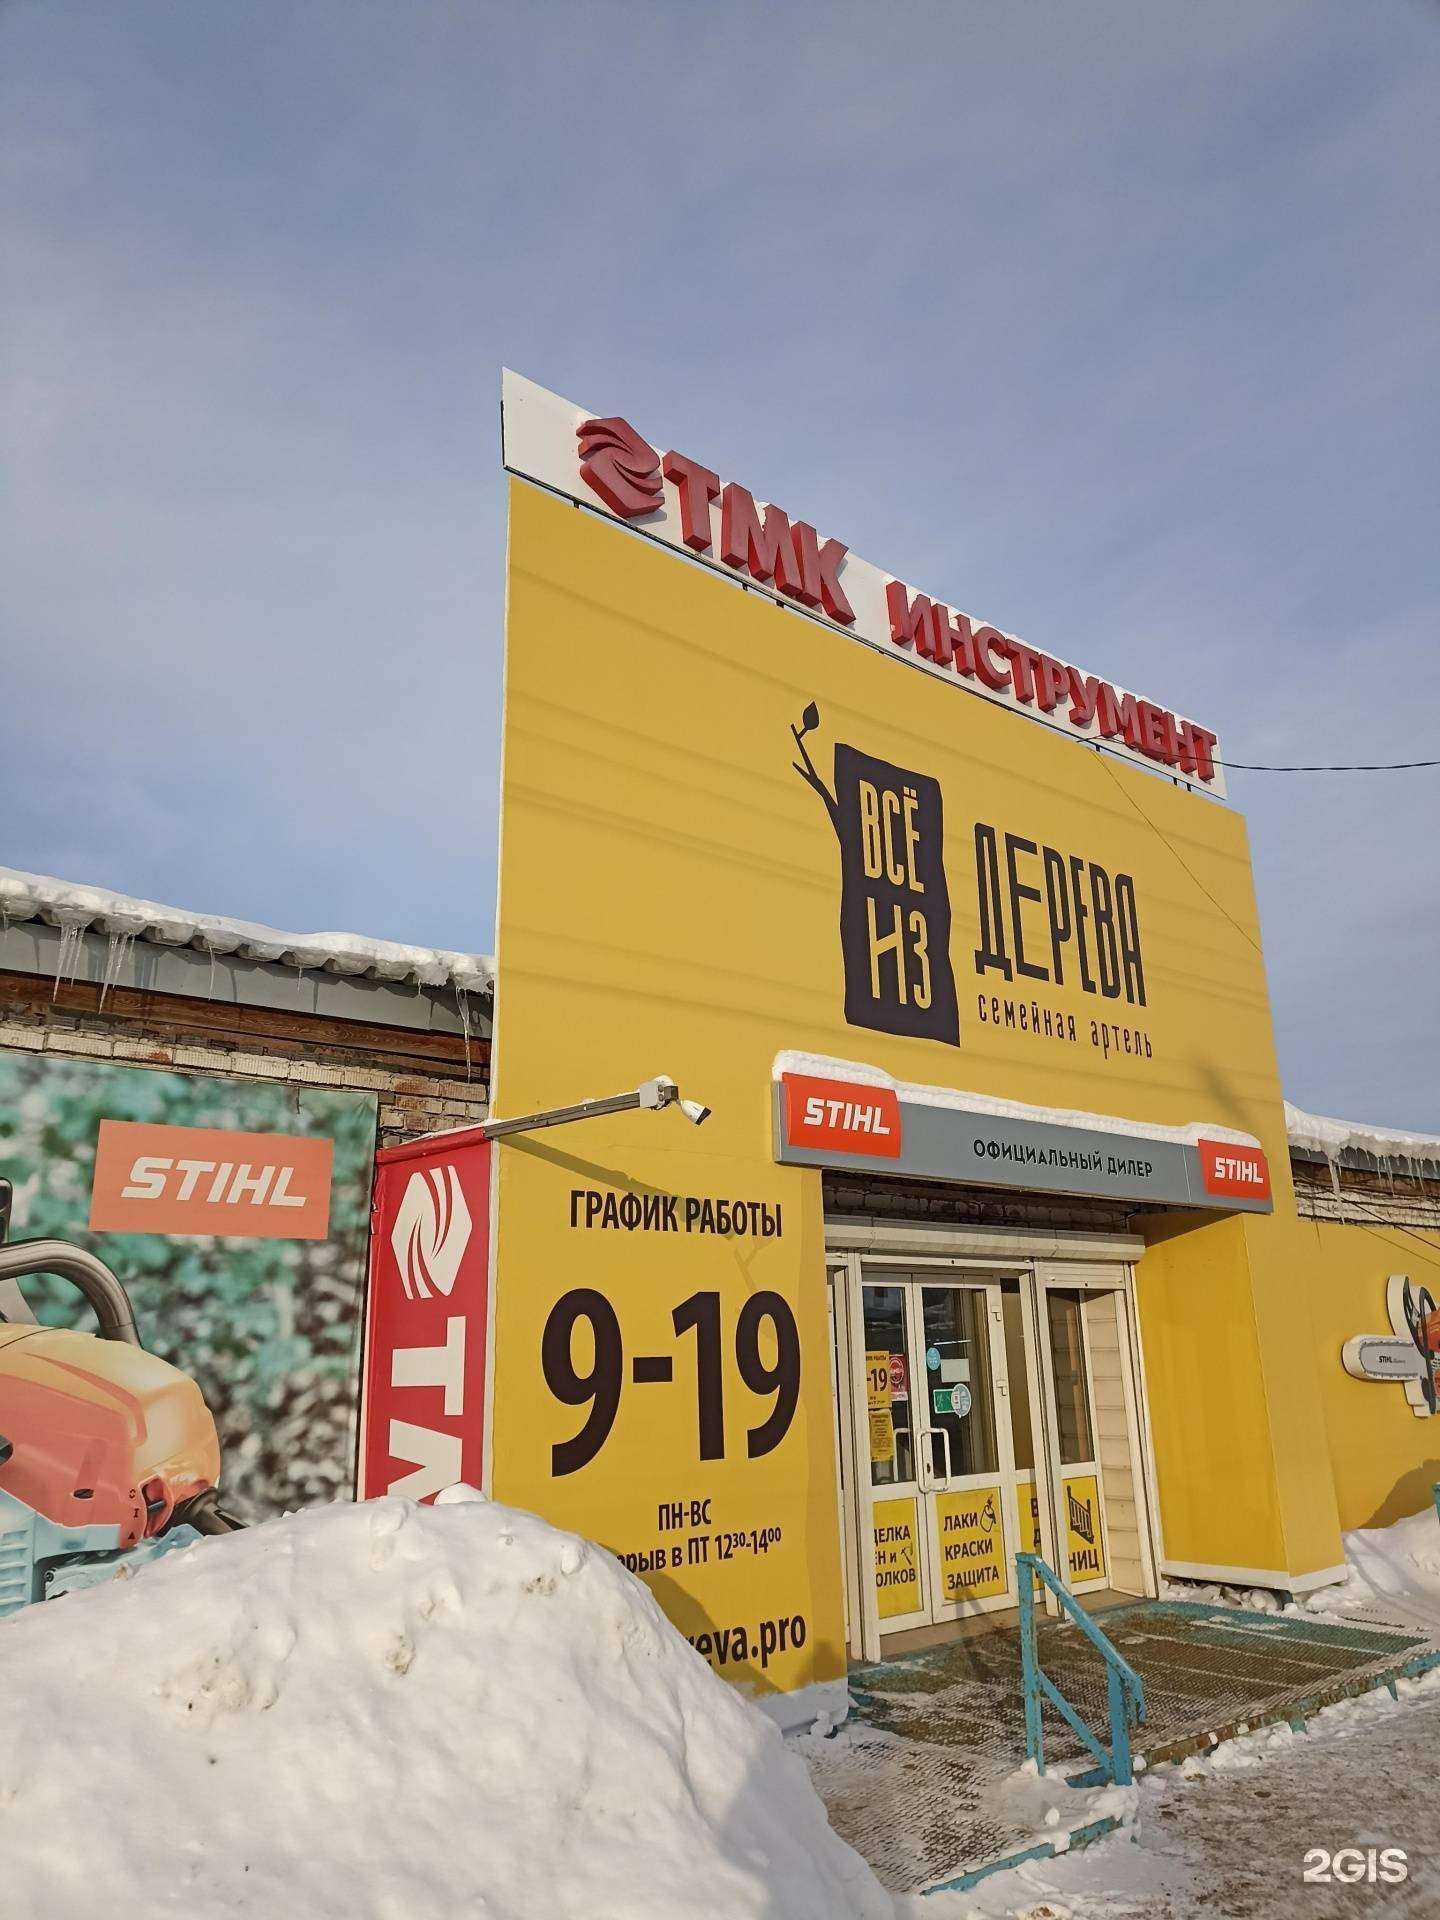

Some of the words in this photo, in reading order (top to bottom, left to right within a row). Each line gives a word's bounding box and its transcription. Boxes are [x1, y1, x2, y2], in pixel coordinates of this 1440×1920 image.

[663, 449, 856, 626] ТМК
[886, 580, 1218, 784] ИНСТРУМЕНТ
[859, 779, 925, 894] ВСЁ
[974, 822, 1147, 1007] ДЕРЕВА
[867, 897, 931, 1009] ИЗ
[977, 993, 1077, 1042] семейная
[1090, 1020, 1153, 1059] артель
[803, 1097, 891, 1136] STIHL
[972, 1138, 1102, 1172] ОФИЦИАЛЬНЫЙ
[1107, 1153, 1153, 1179] ДИЛЕР
[1214, 1156, 1264, 1185] STIHL
[121, 1156, 307, 1207] STIHL
[570, 1190, 678, 1232] ГРАФИК
[685, 1198, 783, 1238] РАБОТЫ
[541, 1287, 801, 1478] 9-19
[658, 1499, 712, 1531] ПН-ВС
[944, 1512, 978, 1532] ЛАКИ
[688, 1536, 710, 1565] ПТ
[944, 1538, 993, 1561] КРАСКИ
[947, 1565, 1000, 1590] ЗАЩИТА
